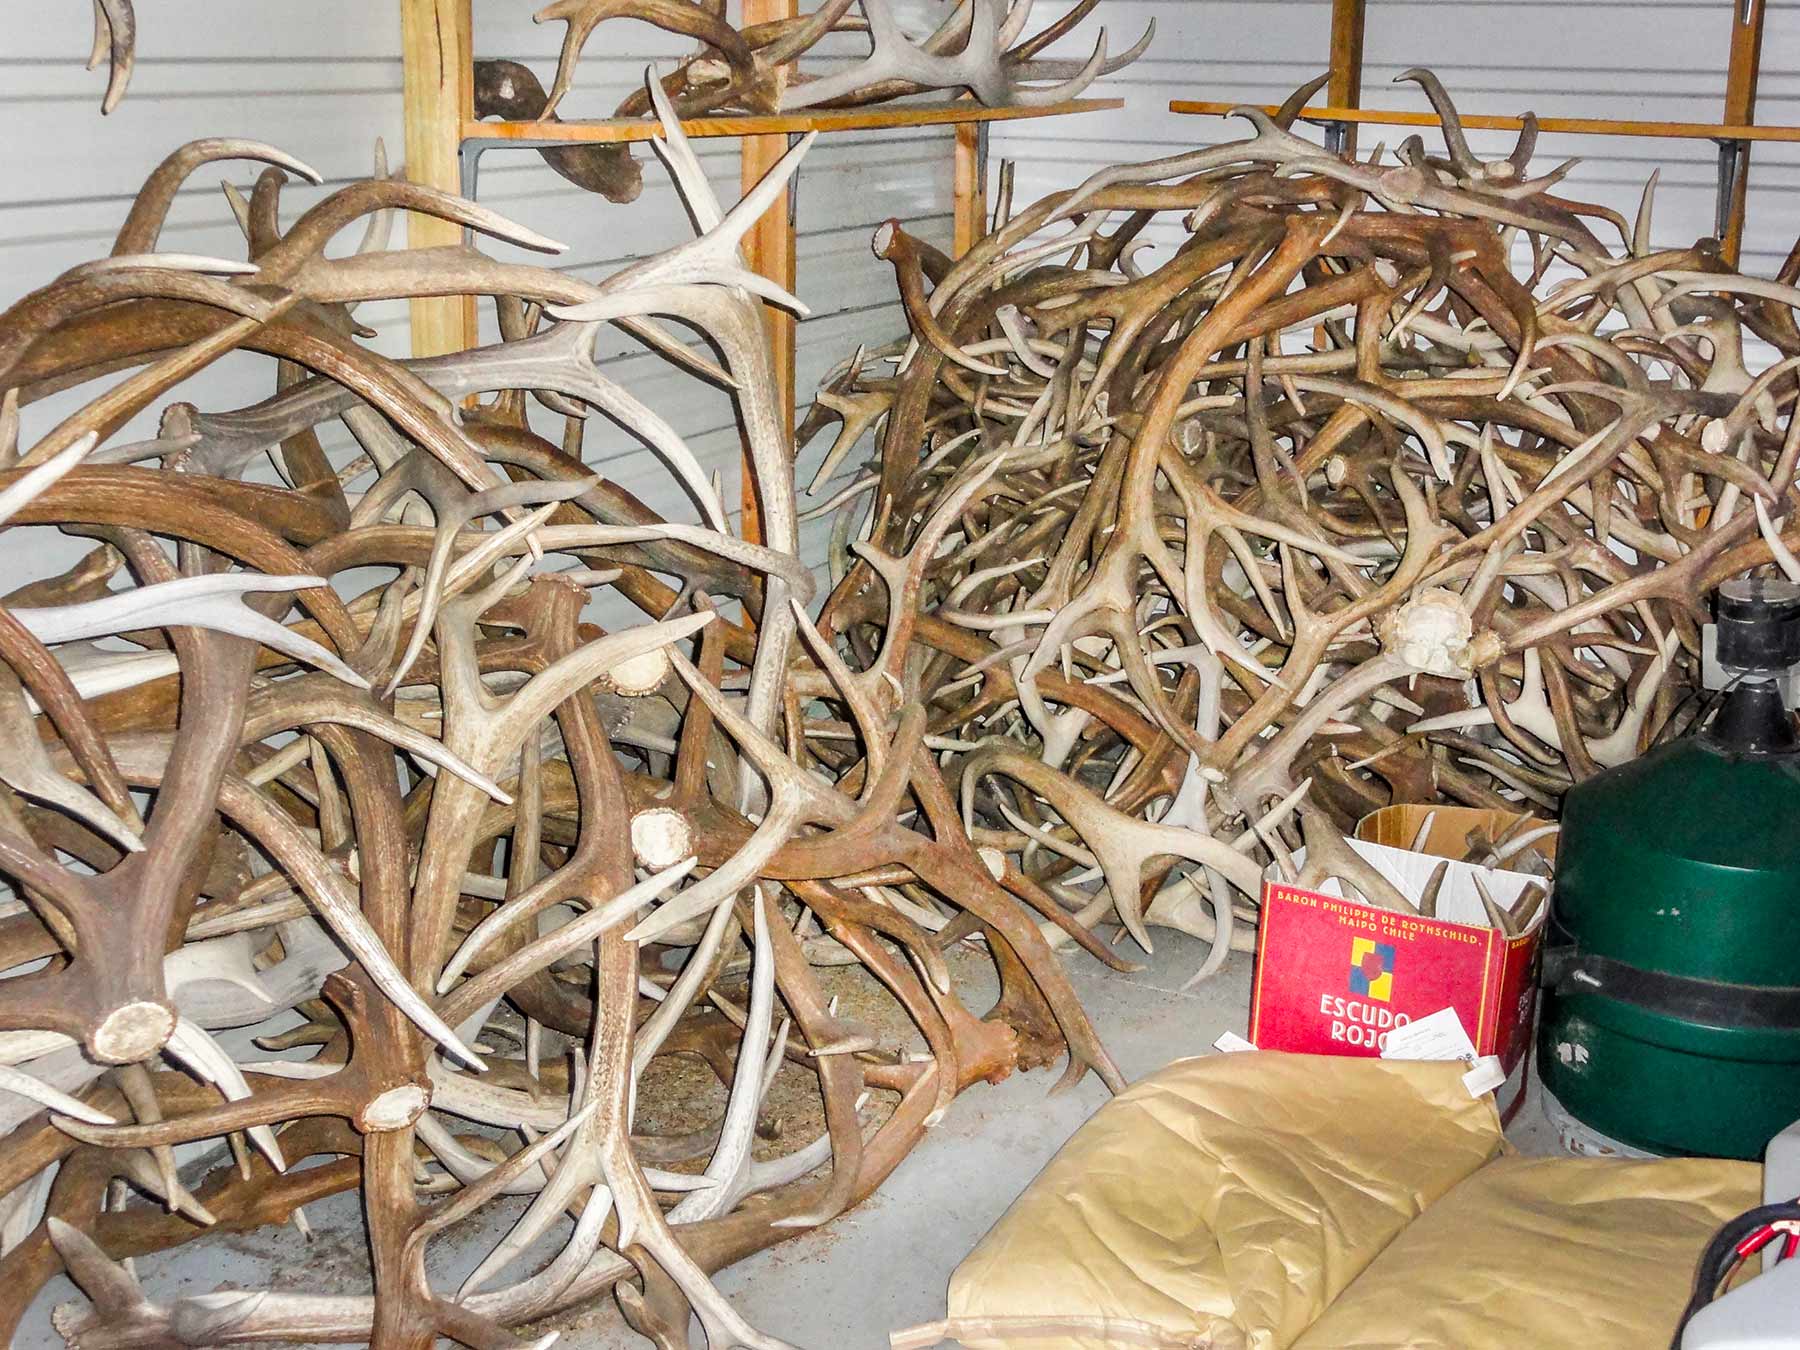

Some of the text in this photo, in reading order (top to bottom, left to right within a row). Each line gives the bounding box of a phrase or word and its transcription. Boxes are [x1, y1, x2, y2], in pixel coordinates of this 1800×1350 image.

[1277, 891, 1317, 907] BARON
[1323, 901, 1376, 921] PHILIPPE
[1381, 914, 1396, 926] DE
[1338, 915, 1416, 941] MAIPO CHILE
[1320, 993, 1411, 1030] ESCUDO
